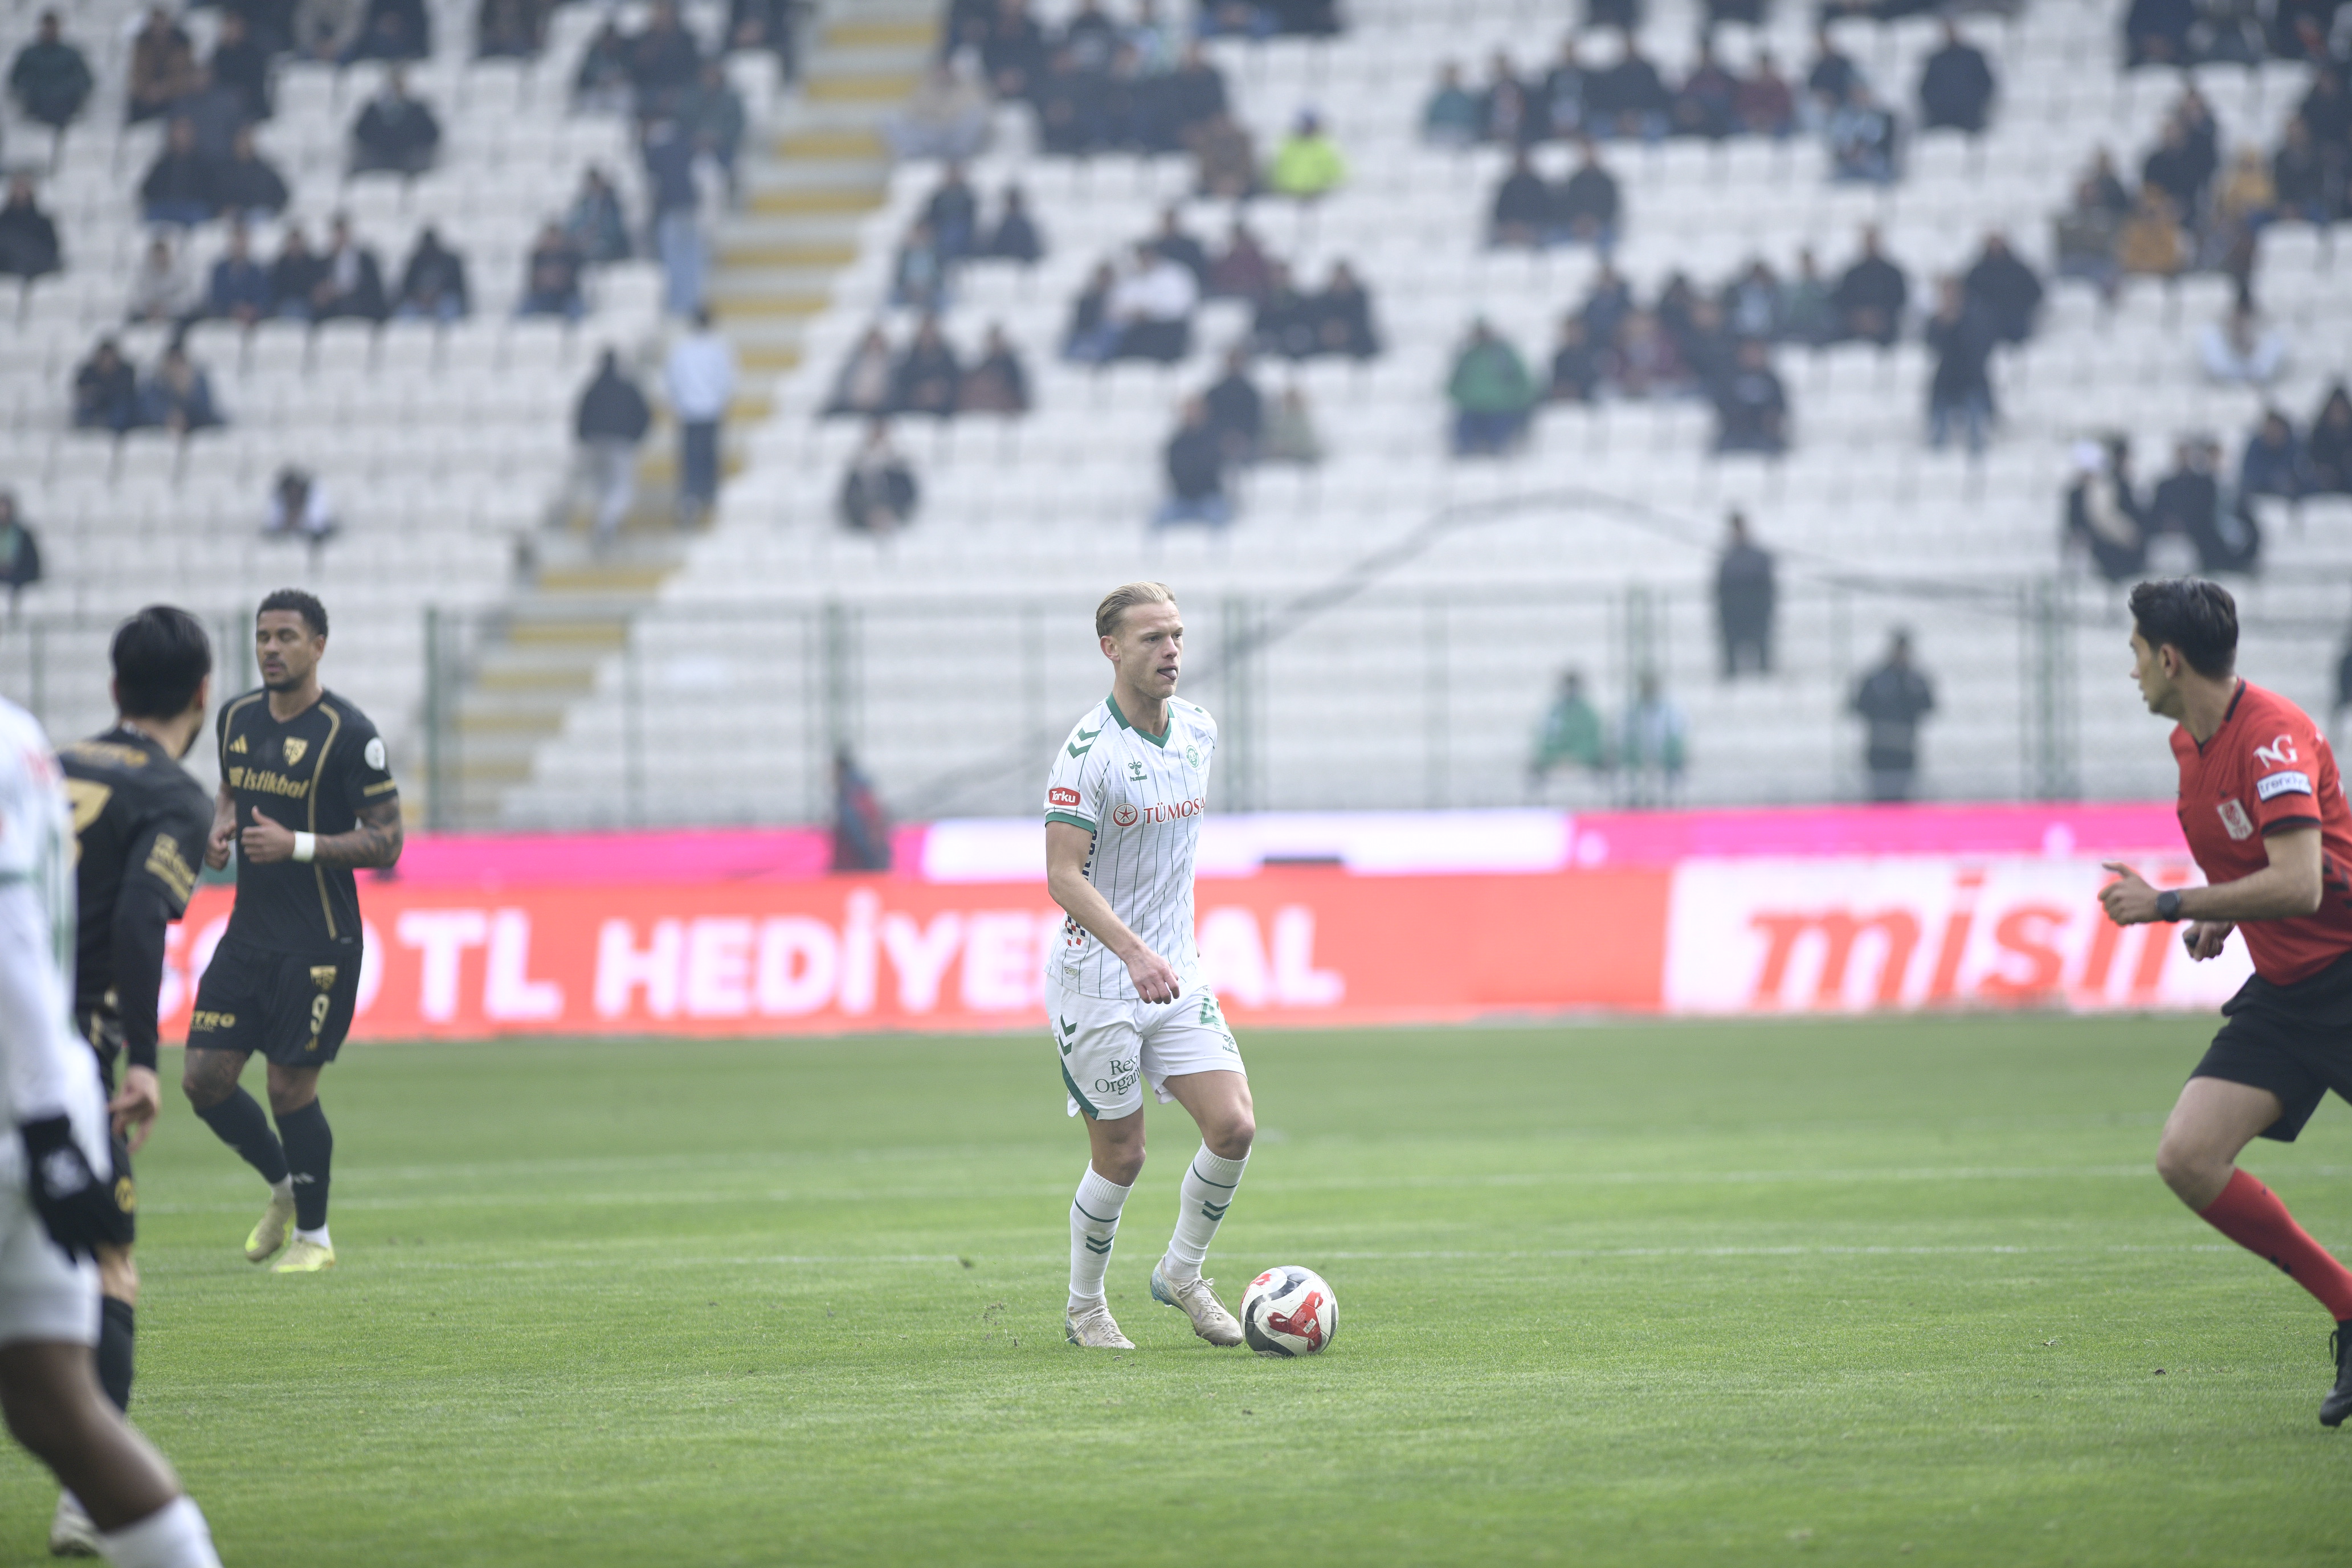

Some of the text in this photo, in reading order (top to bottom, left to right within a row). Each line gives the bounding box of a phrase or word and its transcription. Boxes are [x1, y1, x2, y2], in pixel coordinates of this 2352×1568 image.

[2253, 734, 2298, 769] NG
[1052, 790, 1076, 803] Torku
[394, 909, 563, 1021] TL
[310, 994, 330, 1035] 9
